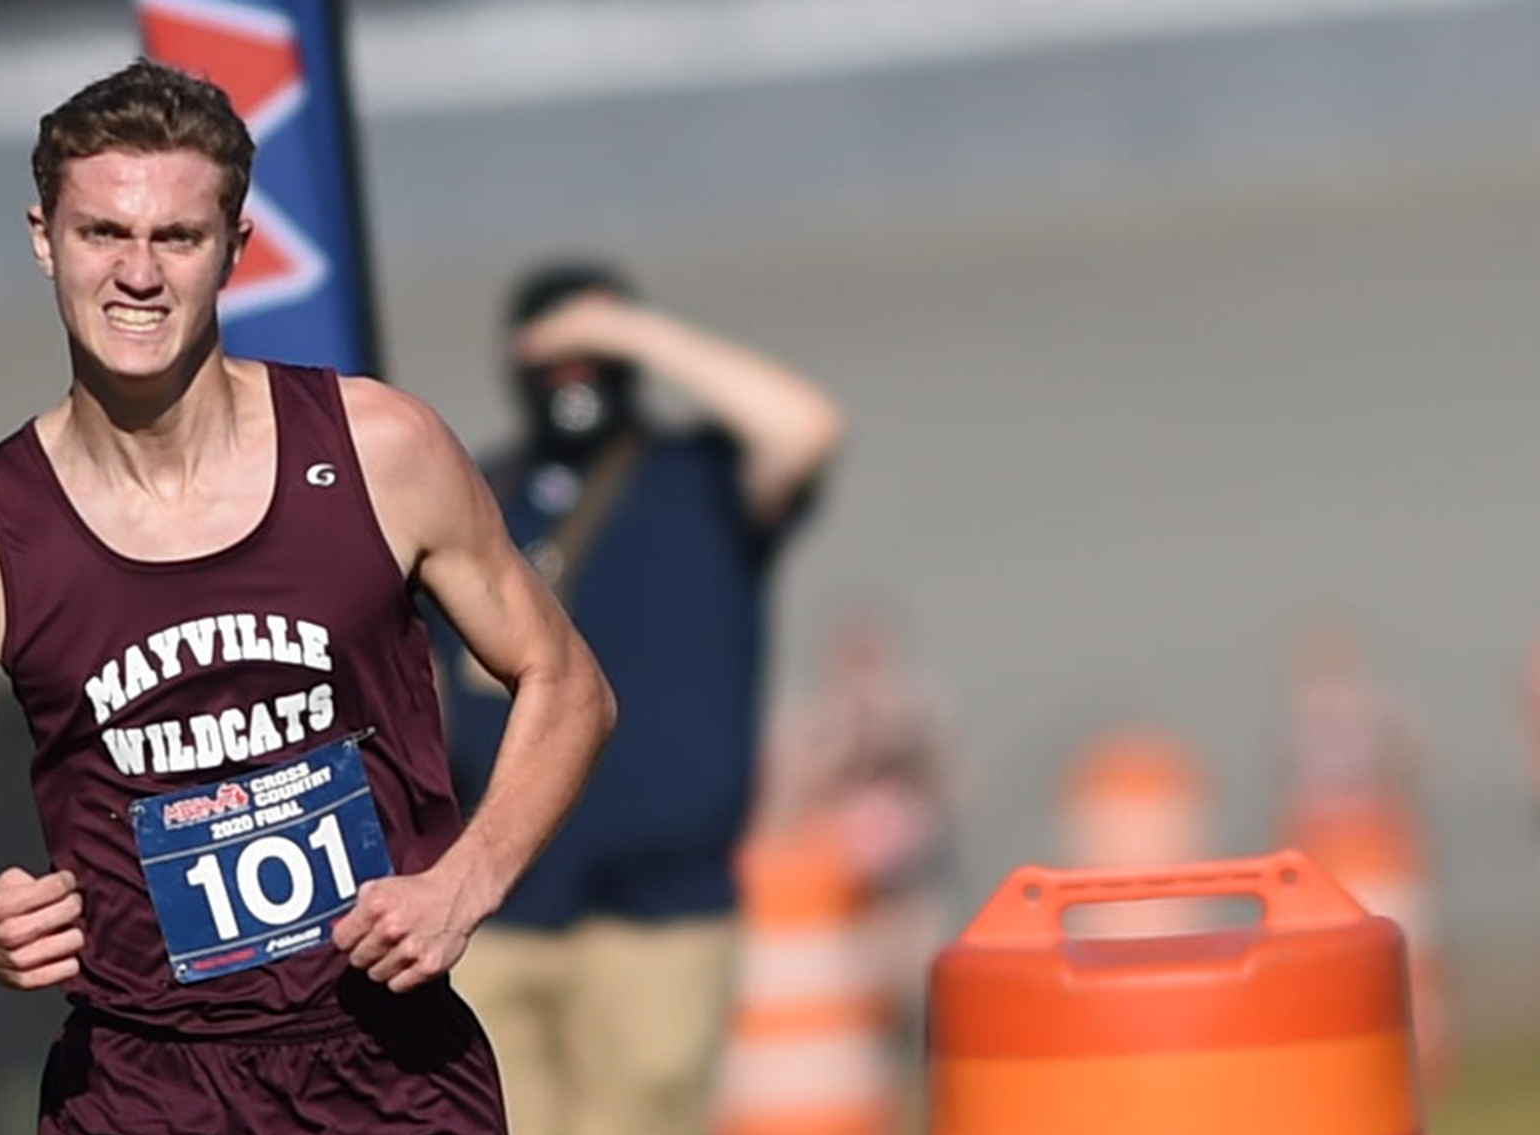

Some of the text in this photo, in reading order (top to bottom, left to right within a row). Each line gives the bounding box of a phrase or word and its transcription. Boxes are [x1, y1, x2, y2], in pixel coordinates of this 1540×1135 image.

[86, 614, 332, 723] MAYVILLE
[102, 684, 334, 775] WILDCATS
[250, 762, 310, 793] CROSS
[254, 766, 332, 807] COUNTRY
[210, 800, 304, 840] 2020 FINAL
[187, 814, 357, 939] 101
